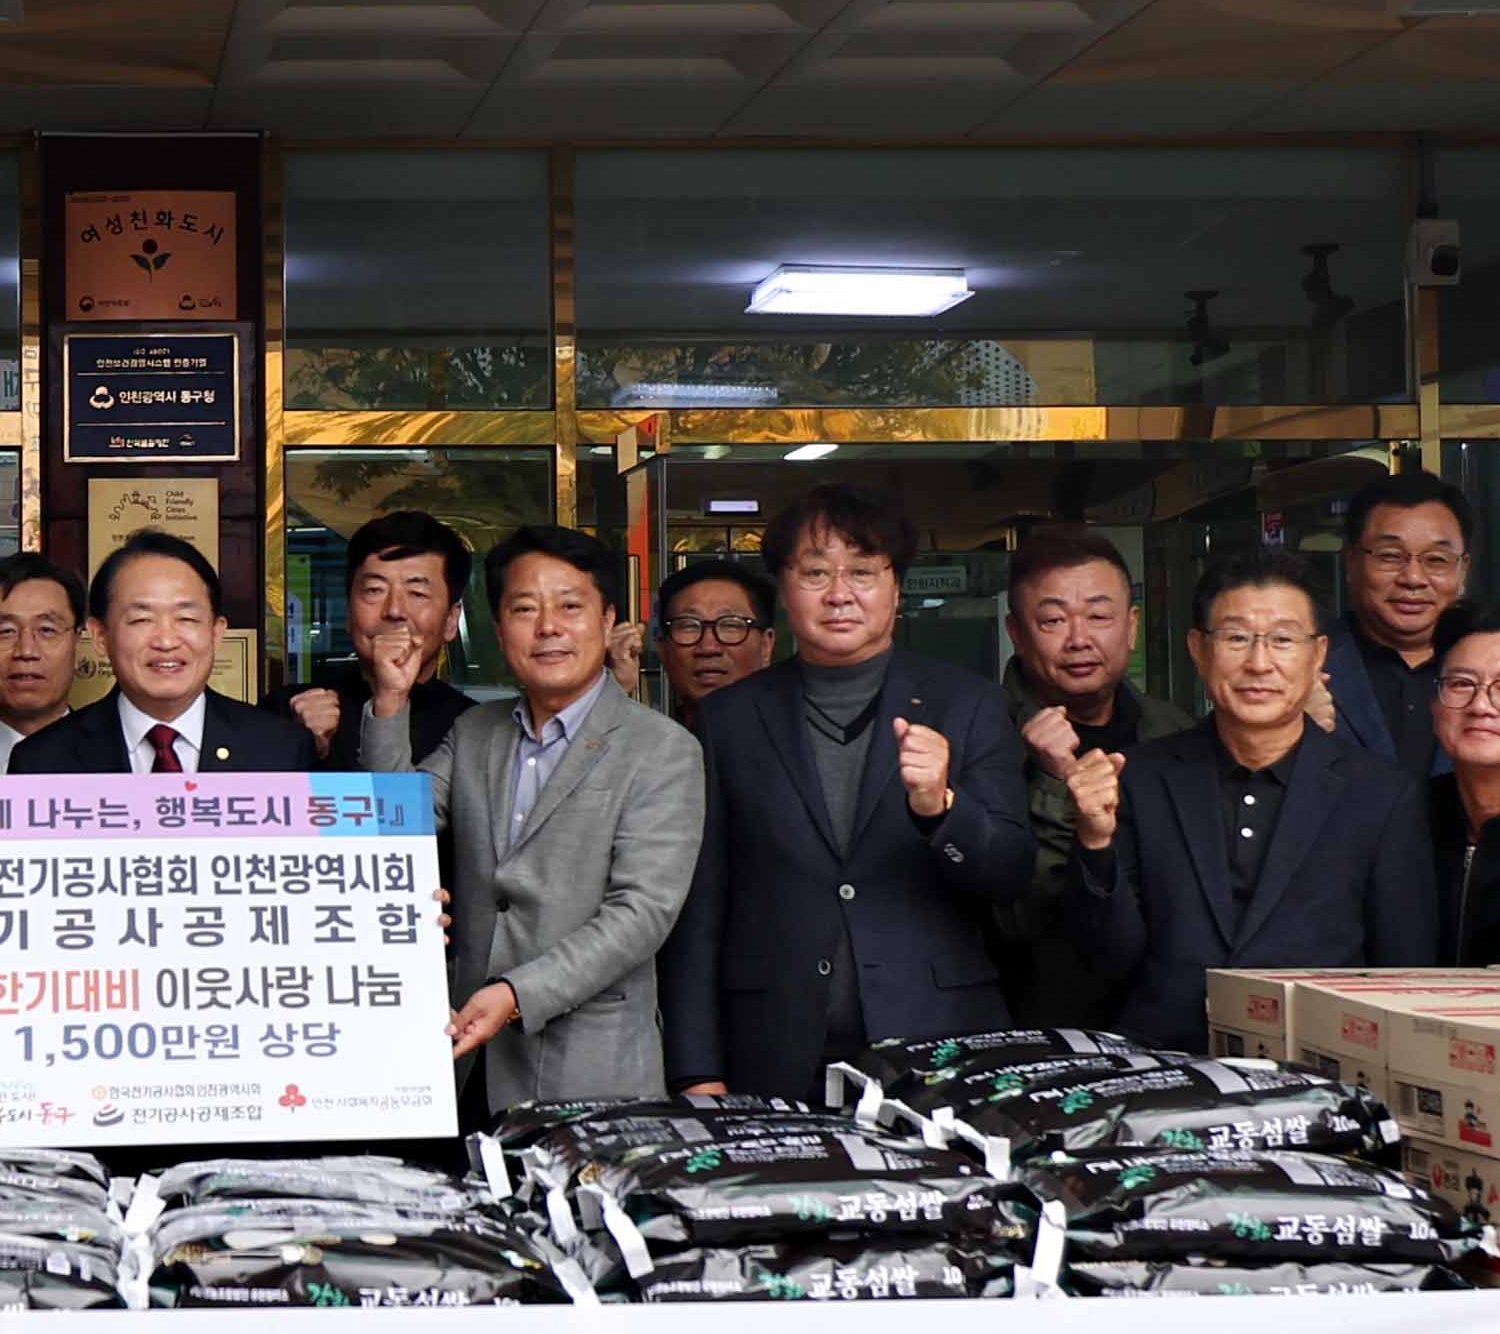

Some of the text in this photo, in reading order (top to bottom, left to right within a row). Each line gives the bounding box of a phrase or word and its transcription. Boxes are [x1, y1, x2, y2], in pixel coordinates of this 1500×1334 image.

[80, 209, 224, 245] 여성친화도시
[119, 390, 216, 404] 인천광역시 동구청
[28, 798, 140, 830] 나누는,
[155, 796, 291, 828] 행복도시
[211, 853, 414, 895] 인천광역시회
[156, 966, 314, 1010] 이웃사랑
[326, 965, 402, 1007] 나눔
[15, 1021, 341, 1068] 1,500만원 상당
[132, 1104, 262, 1125] 전기공사공제조합
[1208, 1116, 1311, 1150] 교동섬쌀
[837, 1191, 948, 1222] 교동섬쌀
[1274, 1214, 1388, 1246] 교동섬쌀
[808, 1265, 919, 1299] 교동섬쌀
